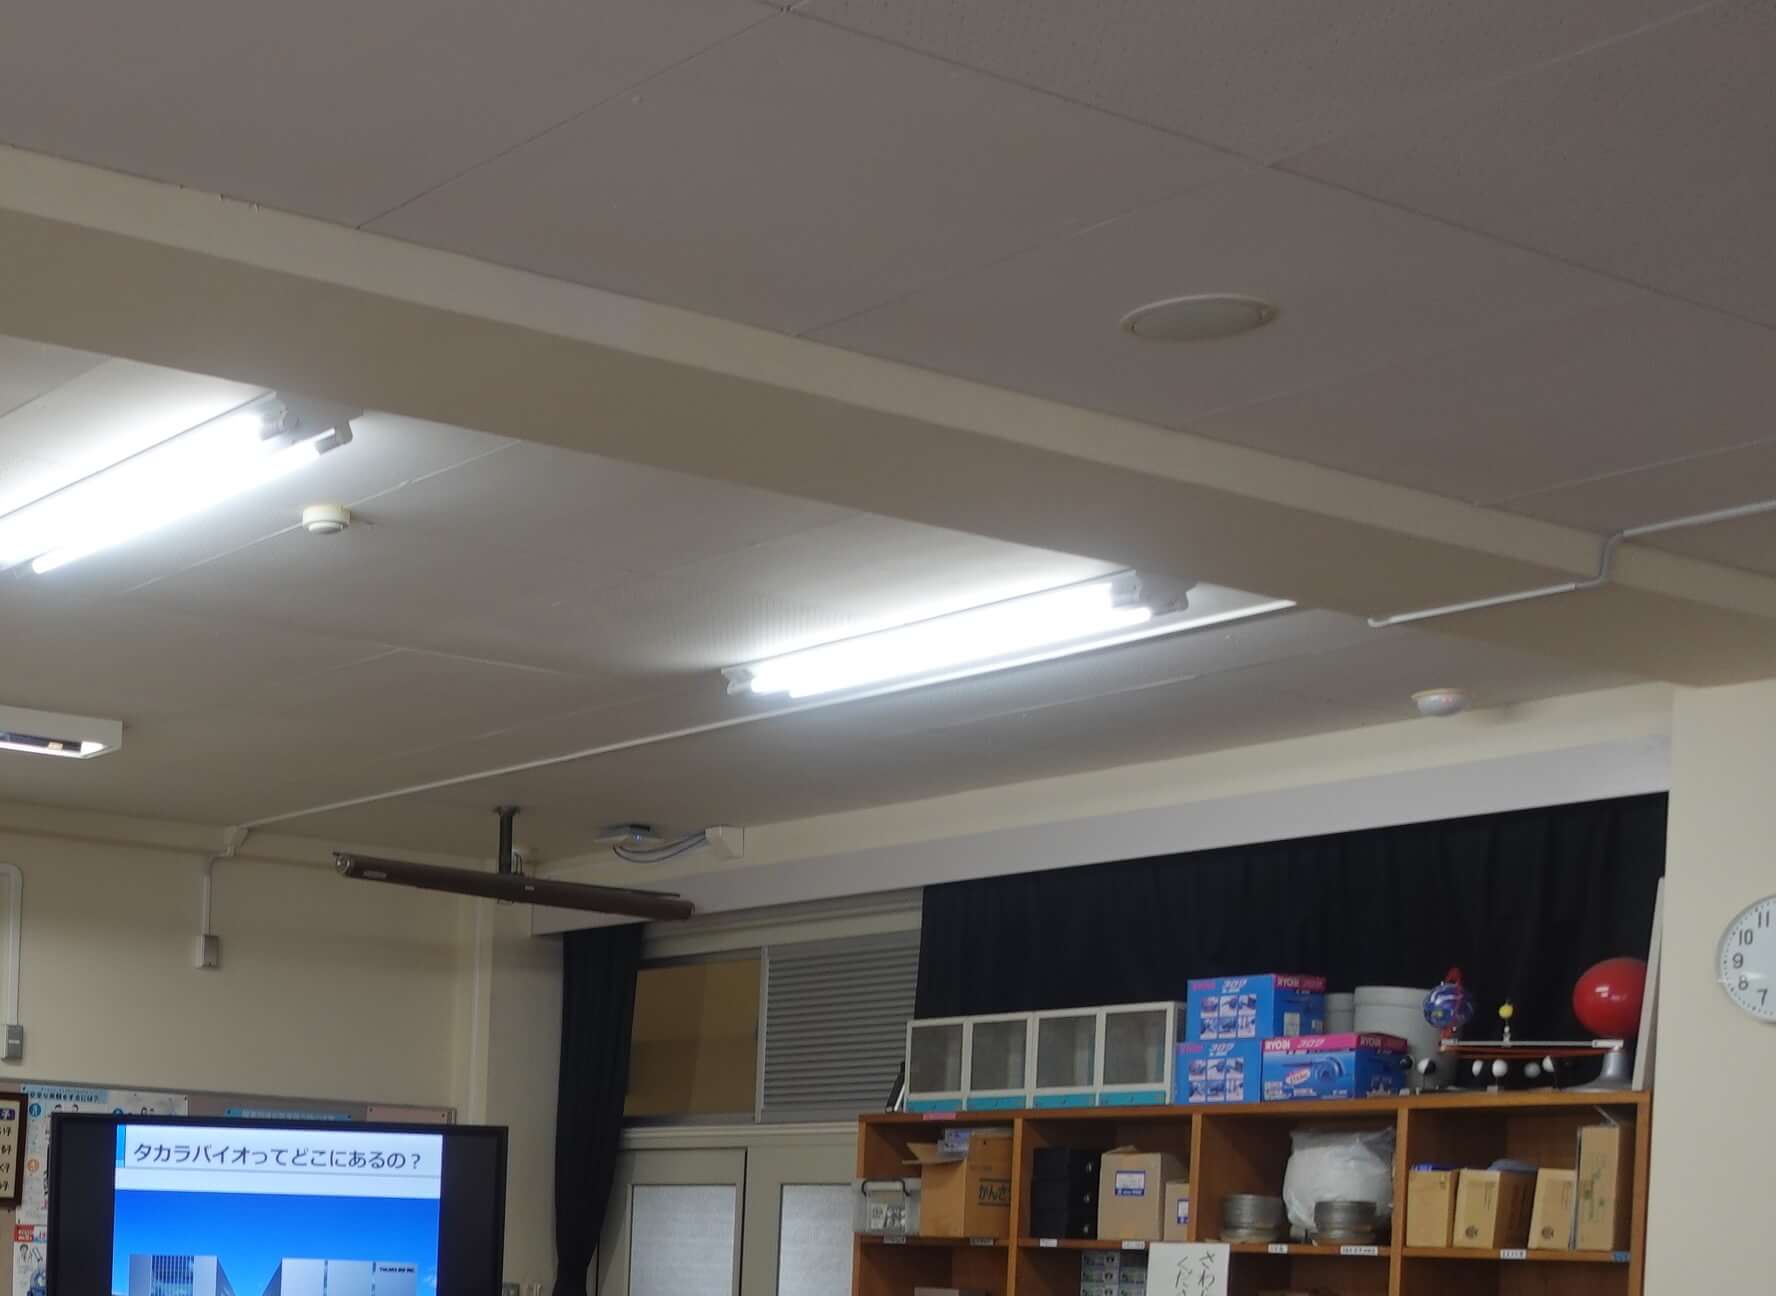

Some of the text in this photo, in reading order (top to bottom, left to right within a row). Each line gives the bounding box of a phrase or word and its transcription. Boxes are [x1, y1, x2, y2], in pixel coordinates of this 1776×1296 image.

[1758, 911, 1770, 928] 11
[1738, 928, 1753, 946] 10
[1732, 952, 1744, 969] 9
[1738, 974, 1749, 991] 8
[1757, 988, 1768, 1006] 7
[133, 1143, 422, 1169] タカラバイオってどこにあるの?
